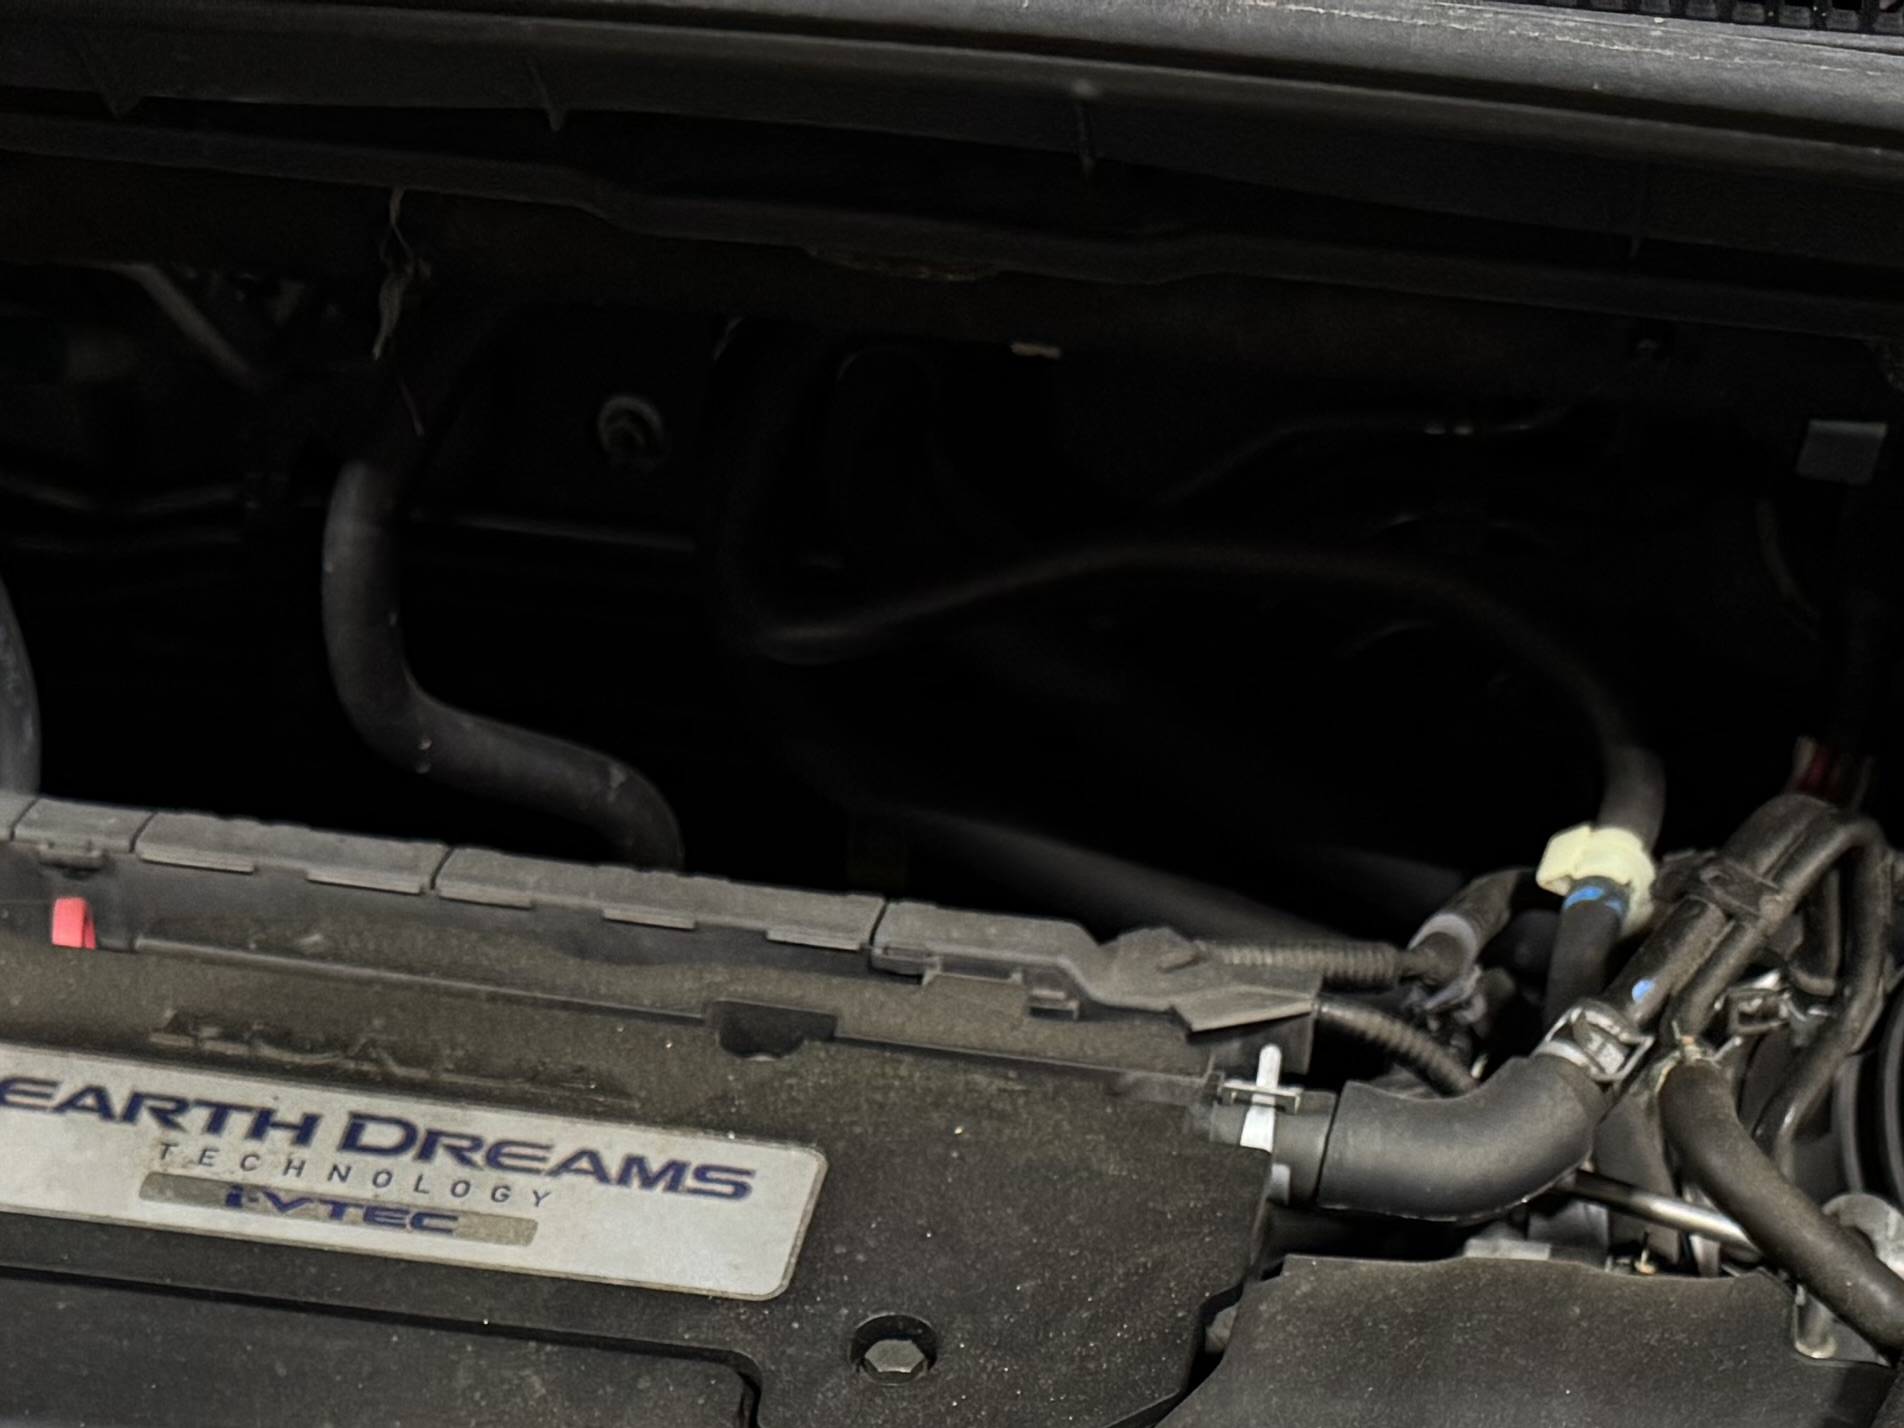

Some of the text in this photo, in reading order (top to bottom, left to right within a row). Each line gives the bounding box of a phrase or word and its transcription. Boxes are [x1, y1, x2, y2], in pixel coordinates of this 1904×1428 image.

[159, 1142, 553, 1207] TECHNOLOGY
[340, 1113, 755, 1201] DREAMS
[226, 1185, 460, 1238] i-VTEC
